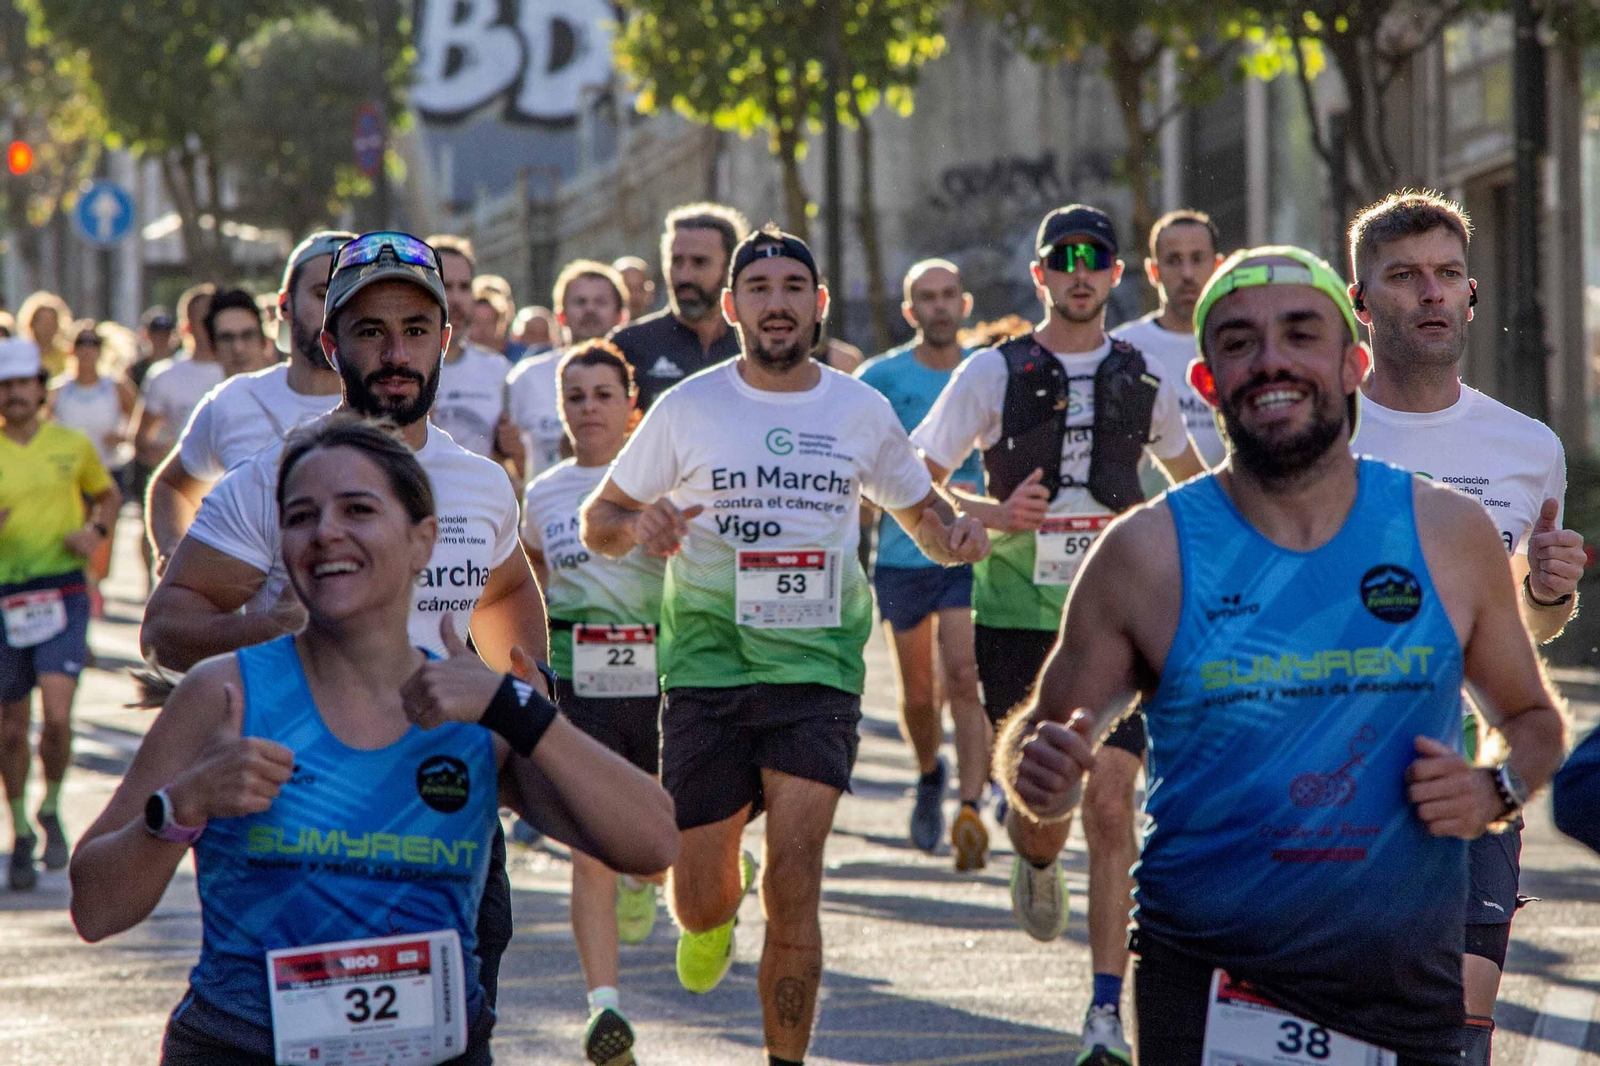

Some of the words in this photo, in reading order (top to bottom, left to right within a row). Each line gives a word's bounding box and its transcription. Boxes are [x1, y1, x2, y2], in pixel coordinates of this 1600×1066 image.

[712, 468, 746, 491] En
[757, 465, 850, 495] Marcha
[1442, 475, 1490, 485] asociación
[714, 497, 763, 509] contra
[768, 496, 781, 508] el
[1484, 498, 1511, 508] cáncer
[715, 514, 781, 543] Vigo
[414, 559, 489, 588] archa
[776, 573, 807, 595] 53
[607, 648, 636, 666] 22
[1201, 646, 1435, 690] SUMYRENT
[248, 825, 478, 868] SUMYRENT
[345, 984, 398, 1024] 32
[1276, 1020, 1331, 1060] 38
